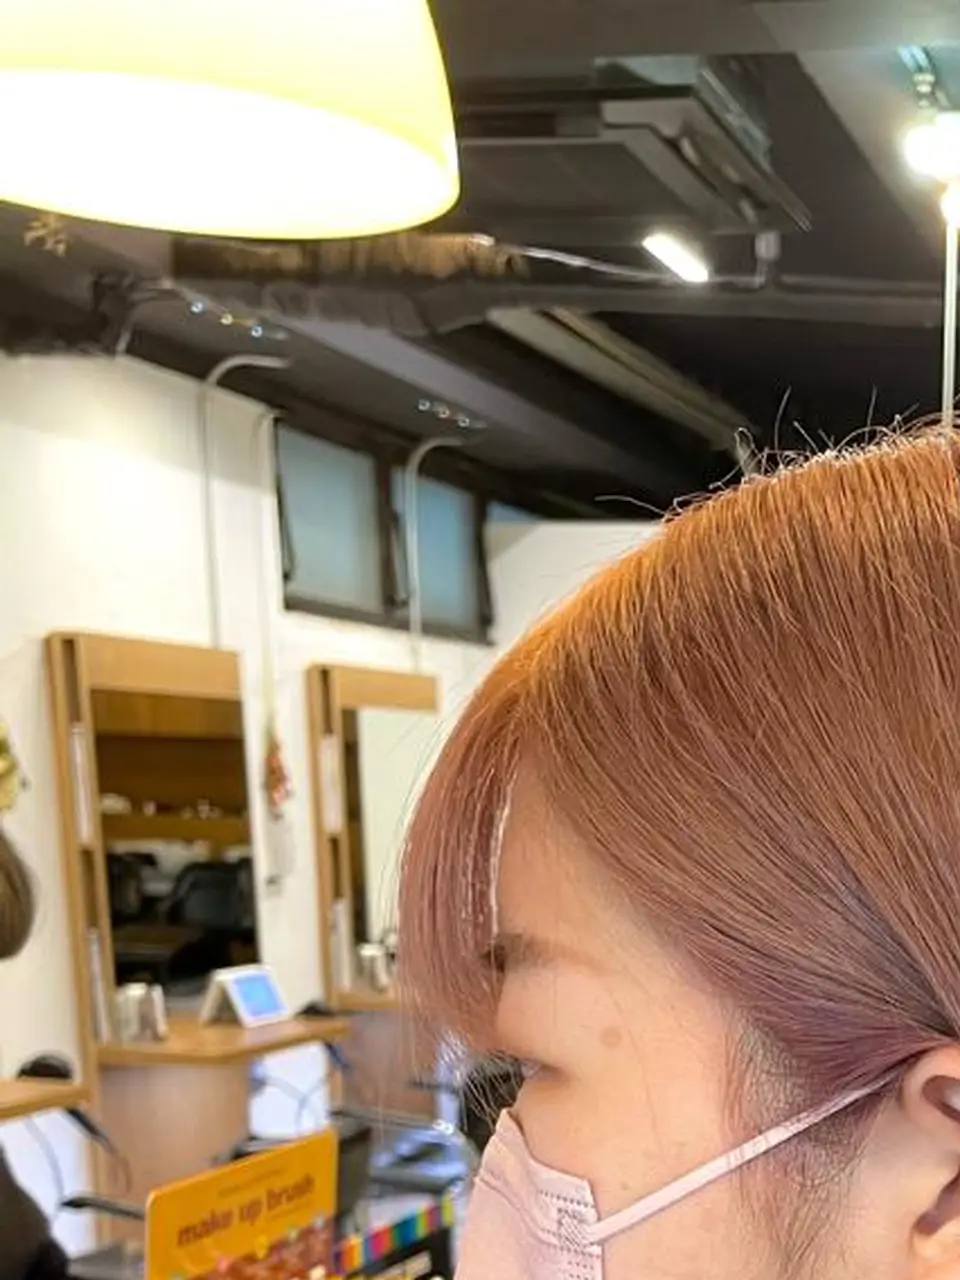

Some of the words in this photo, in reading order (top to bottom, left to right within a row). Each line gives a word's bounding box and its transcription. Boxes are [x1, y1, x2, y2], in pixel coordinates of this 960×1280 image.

[178, 1207, 234, 1246] make
[239, 1197, 264, 1227] up
[267, 1174, 316, 1211] brush
